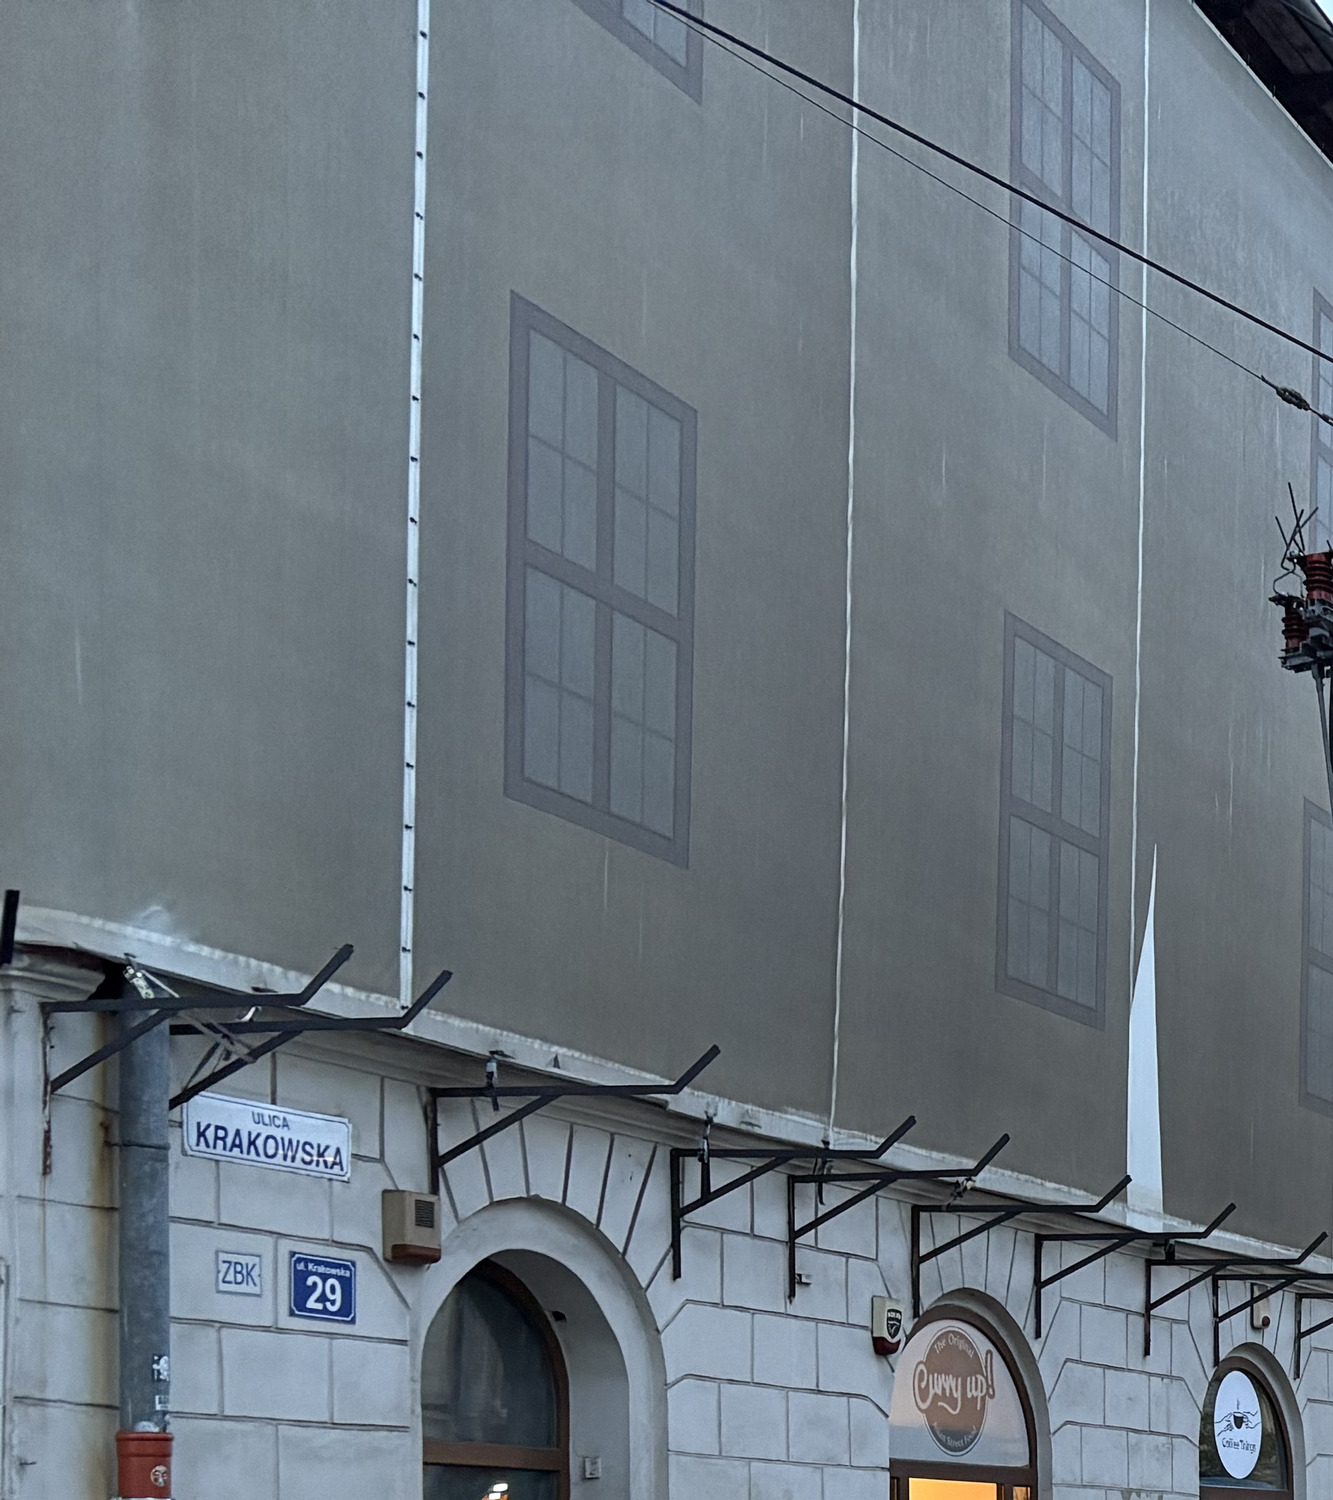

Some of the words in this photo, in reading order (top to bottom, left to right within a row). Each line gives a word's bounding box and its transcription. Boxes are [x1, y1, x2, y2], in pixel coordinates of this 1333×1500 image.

[251, 1110, 290, 1131] ULICA
[195, 1121, 345, 1172] KRAKOWSKA
[221, 1259, 258, 1287] ZBK
[305, 1275, 342, 1313] 29
[914, 1363, 962, 1415] Curry
